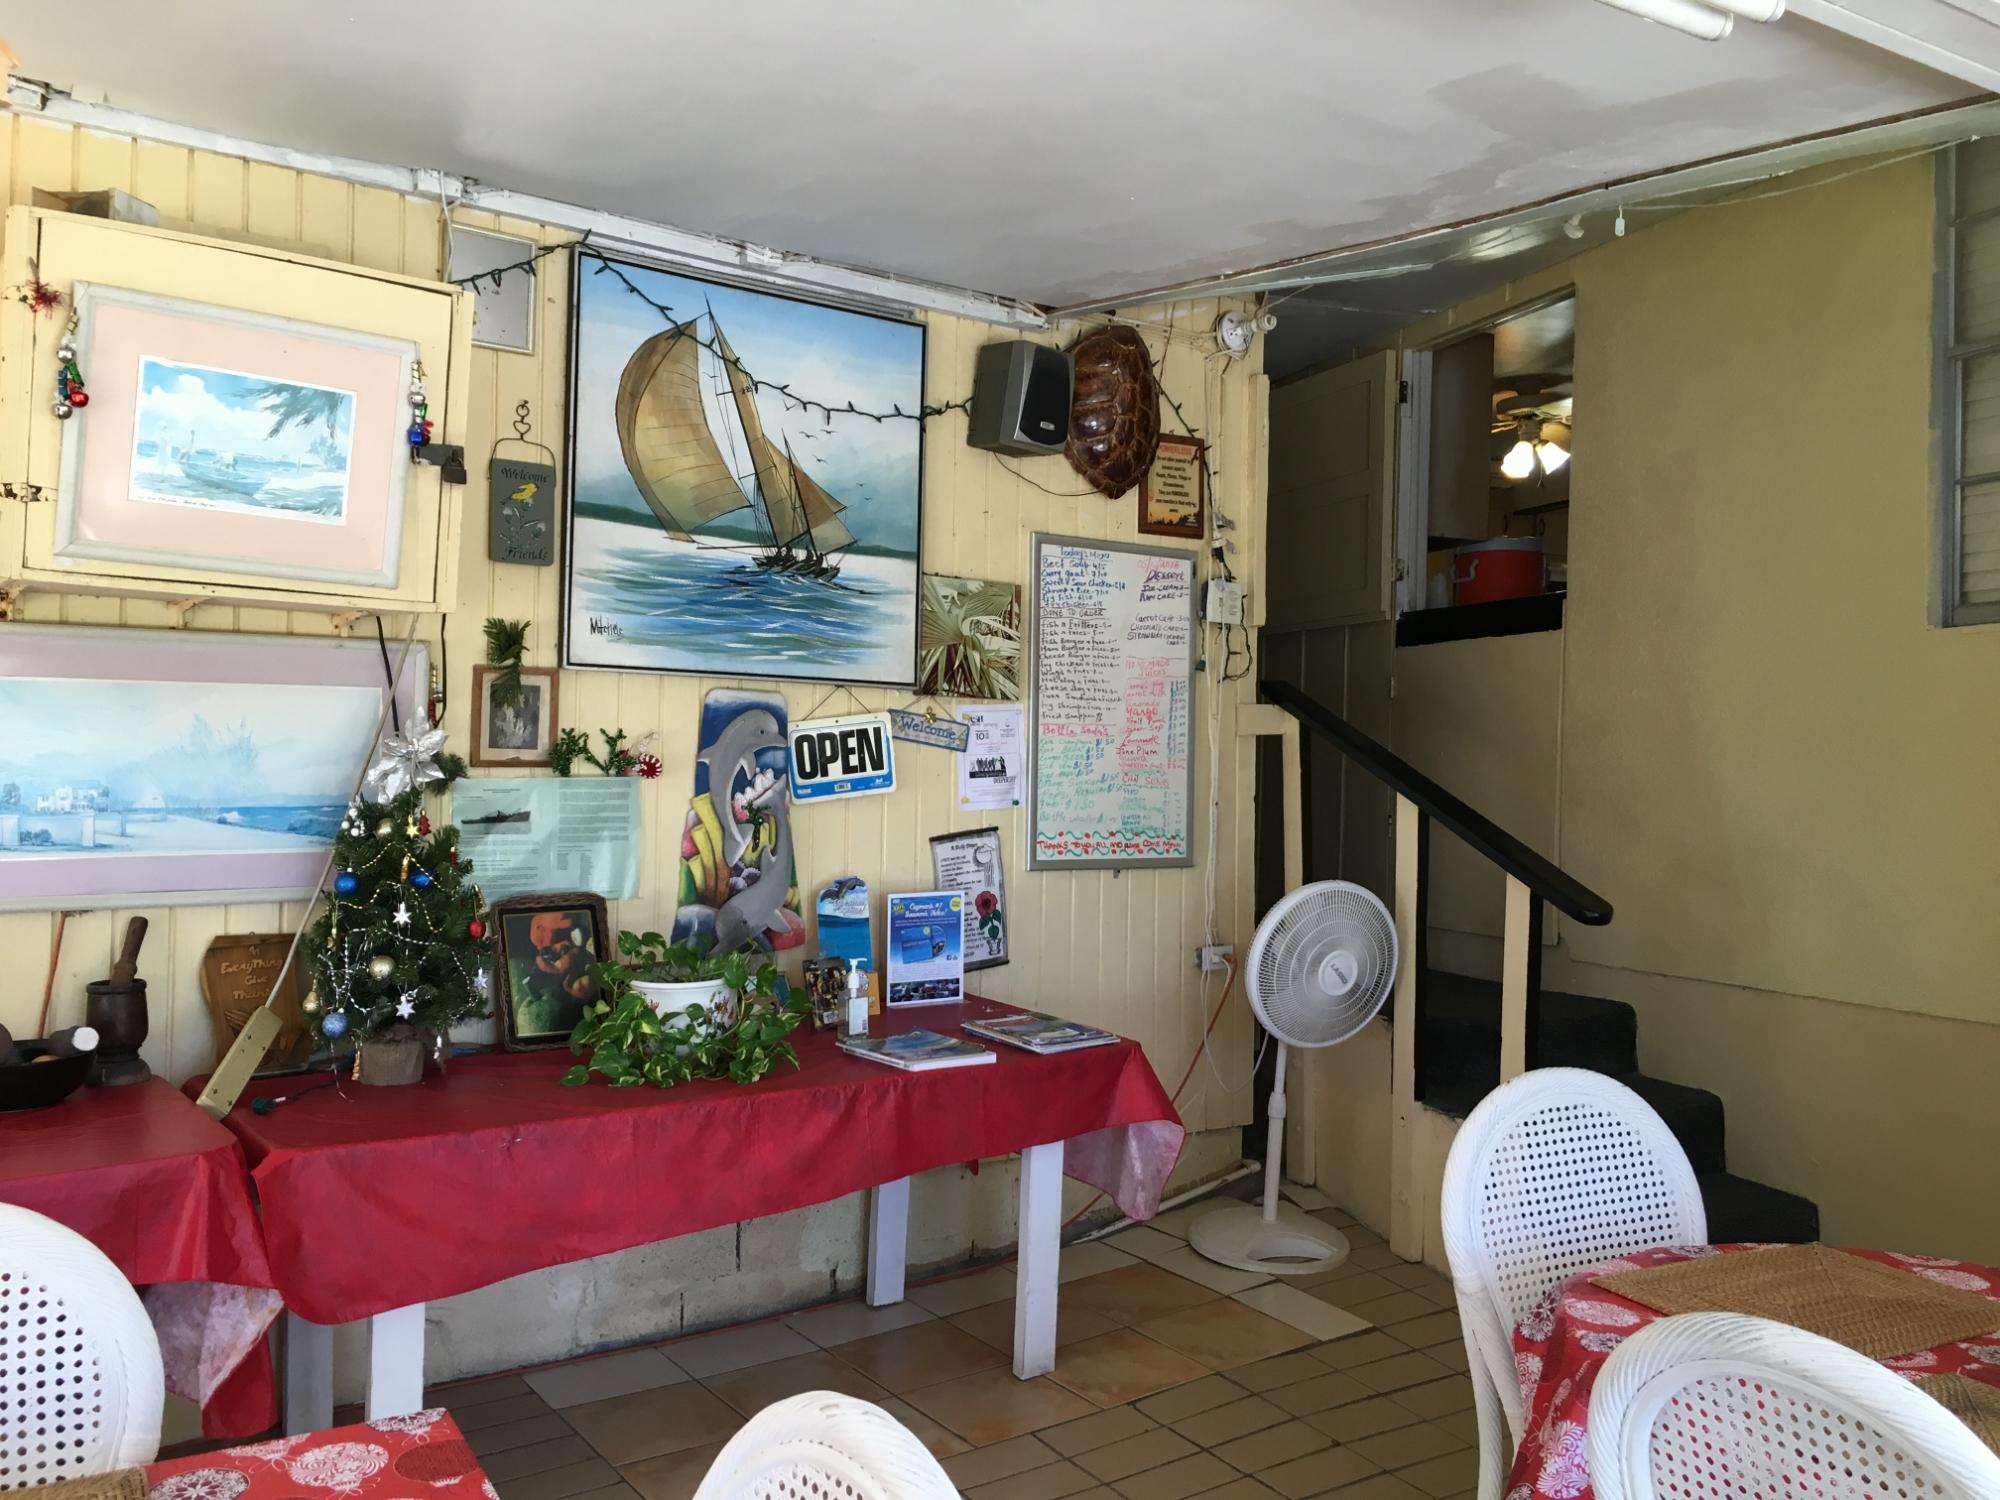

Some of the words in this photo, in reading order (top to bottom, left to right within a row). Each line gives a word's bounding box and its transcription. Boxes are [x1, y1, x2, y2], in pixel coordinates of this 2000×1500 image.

[501, 467, 550, 483] Welcome
[502, 545, 548, 561] Friends
[901, 716, 957, 740] Welcome
[975, 732, 985, 741] 10
[794, 726, 885, 780] OPEN
